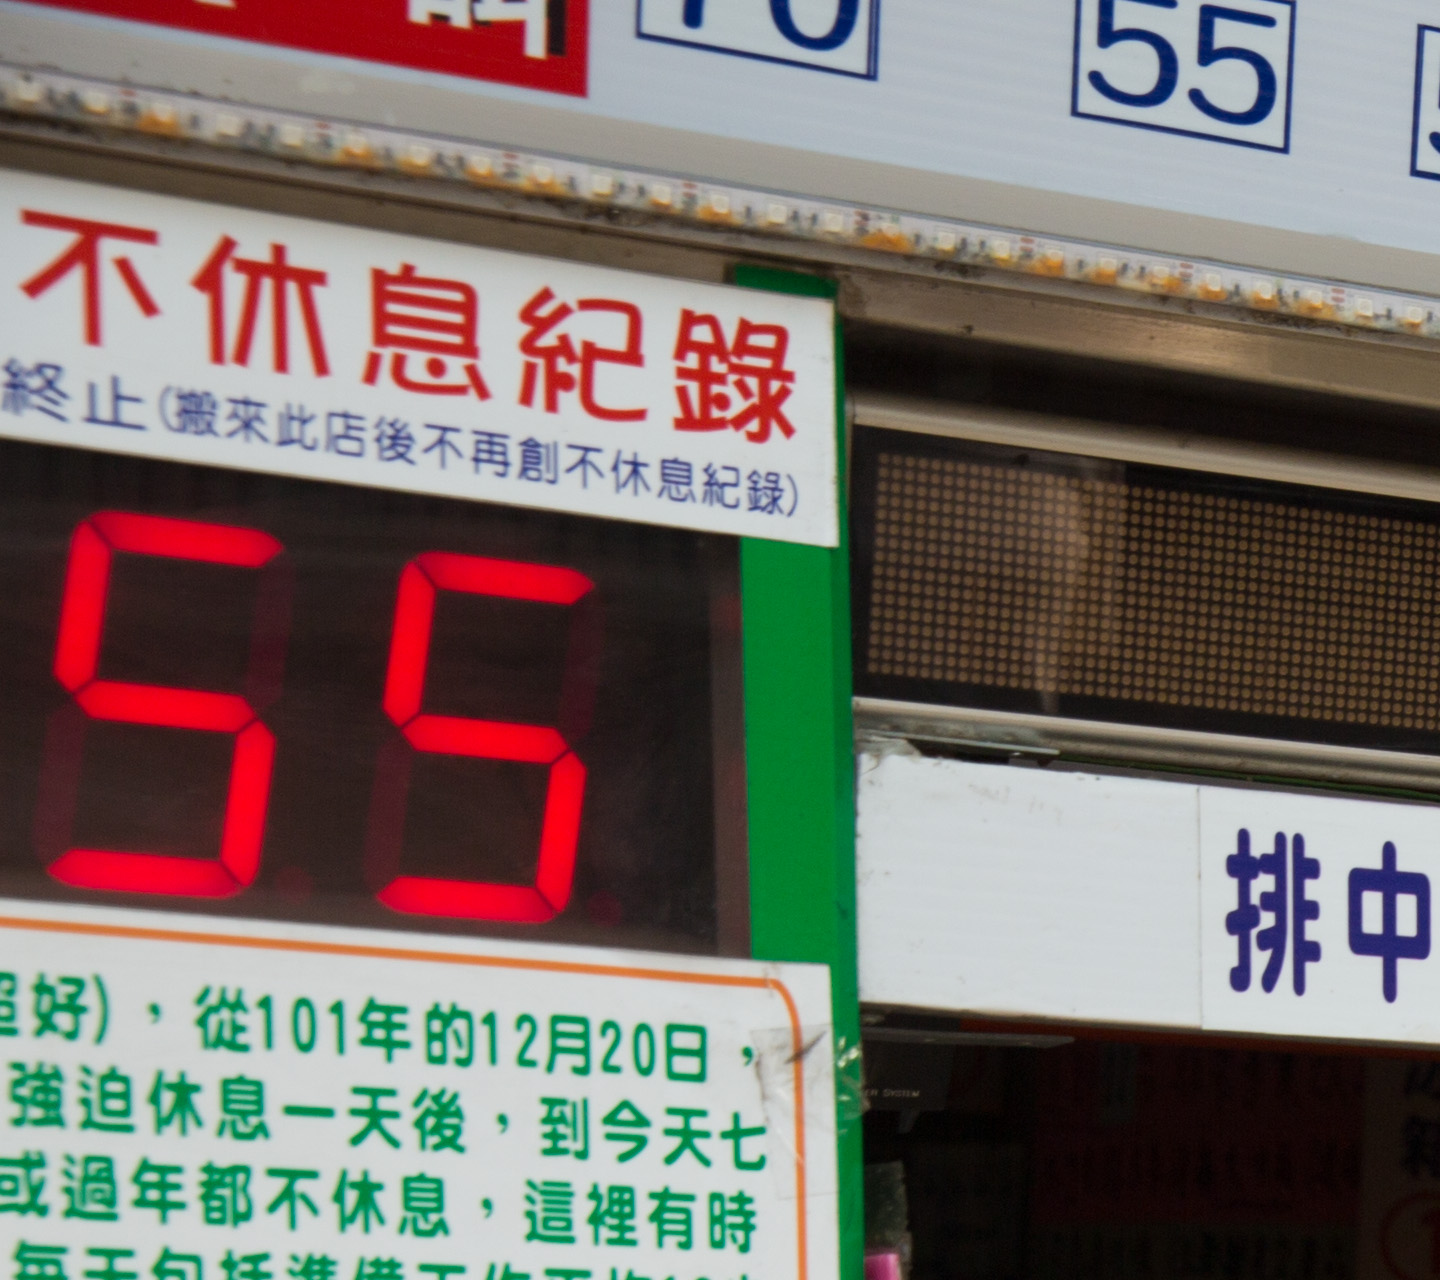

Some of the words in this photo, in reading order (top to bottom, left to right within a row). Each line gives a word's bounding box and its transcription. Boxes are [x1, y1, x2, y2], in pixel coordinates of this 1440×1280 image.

[1086, 0, 1279, 127] 55
[20, 208, 798, 446] 不休息紀錄
